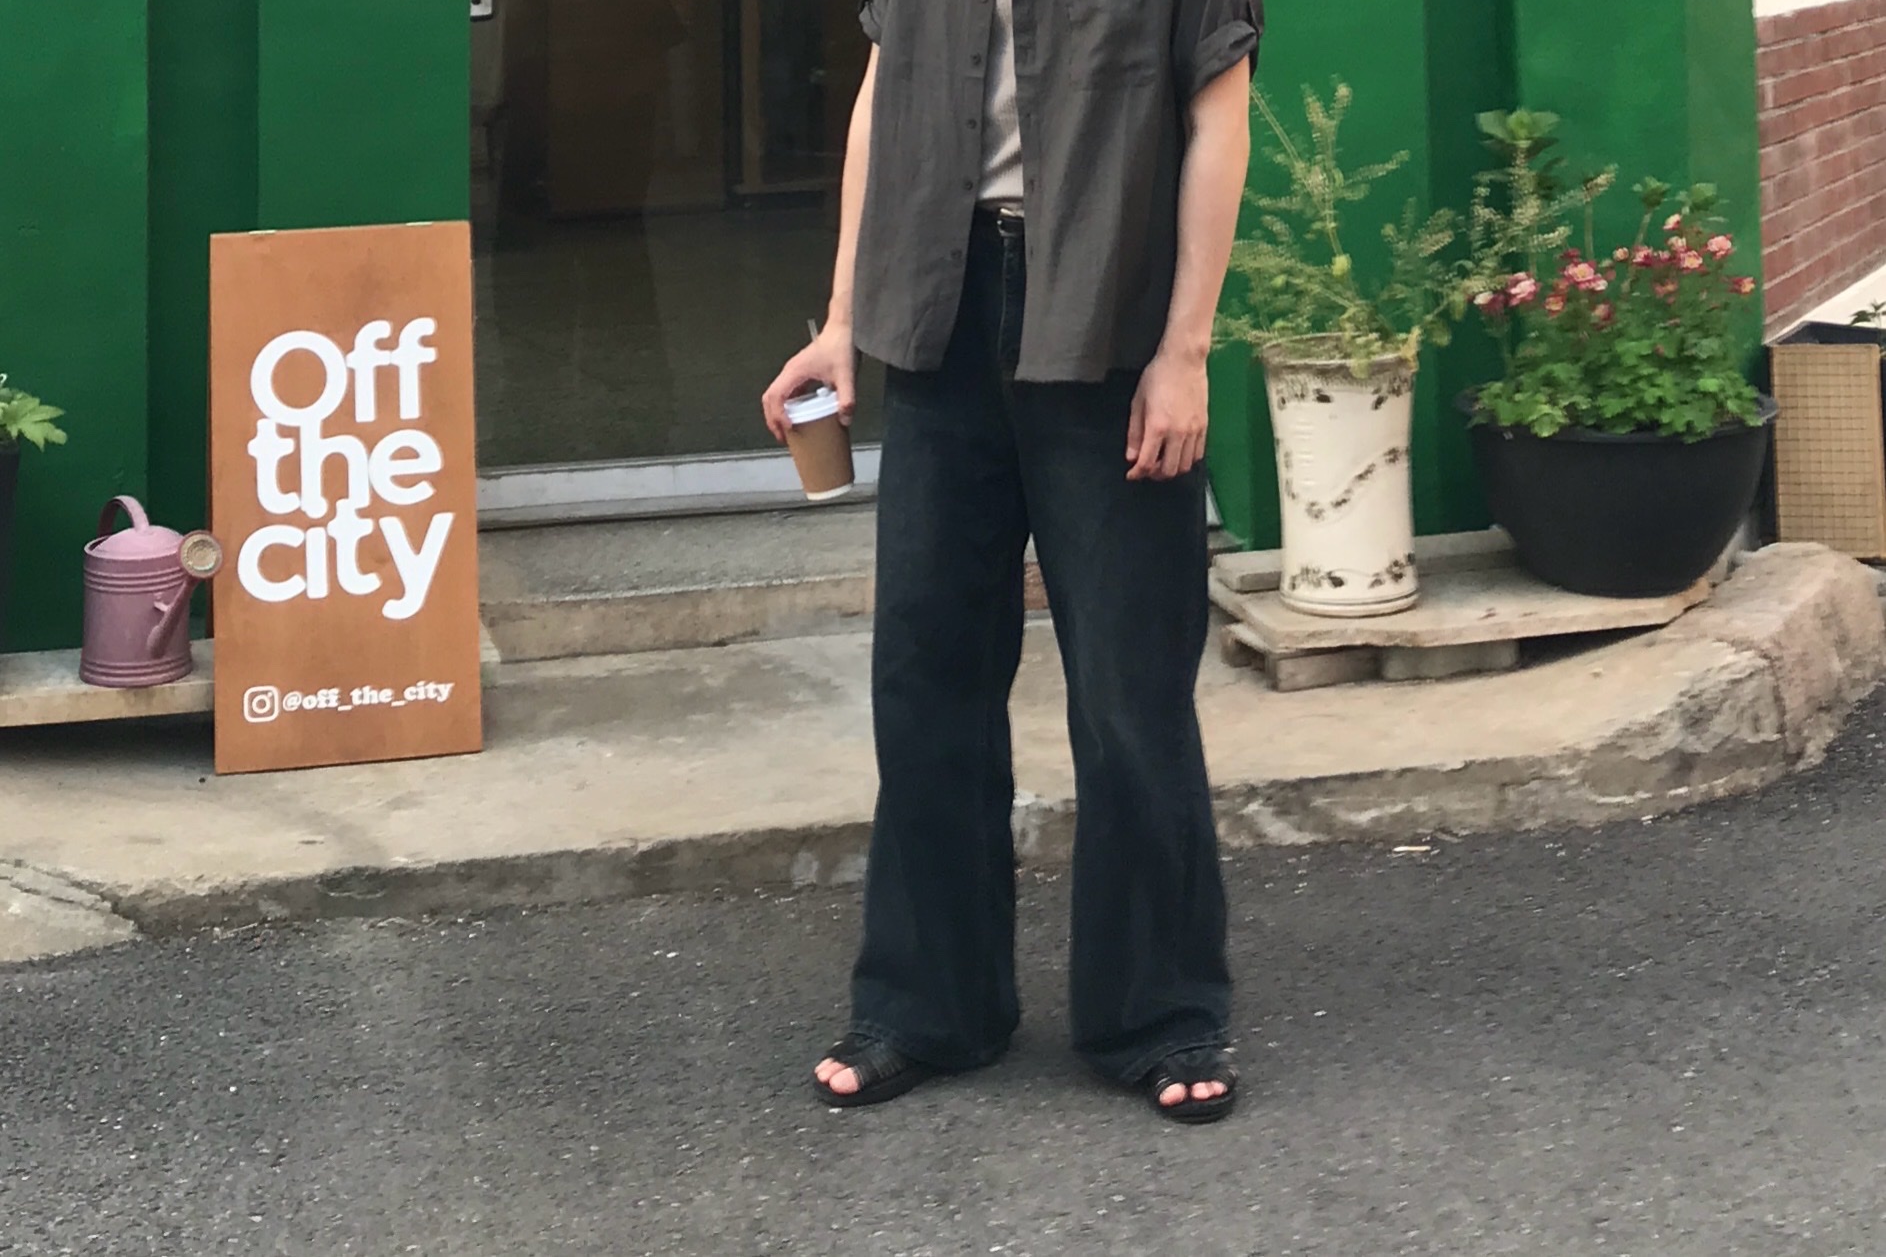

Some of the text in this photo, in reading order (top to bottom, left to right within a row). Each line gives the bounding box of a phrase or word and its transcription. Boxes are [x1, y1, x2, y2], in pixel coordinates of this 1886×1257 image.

[250, 316, 438, 427] Off
[247, 417, 443, 519] the
[237, 498, 455, 620] city
[282, 680, 455, 711] @off_the_city
